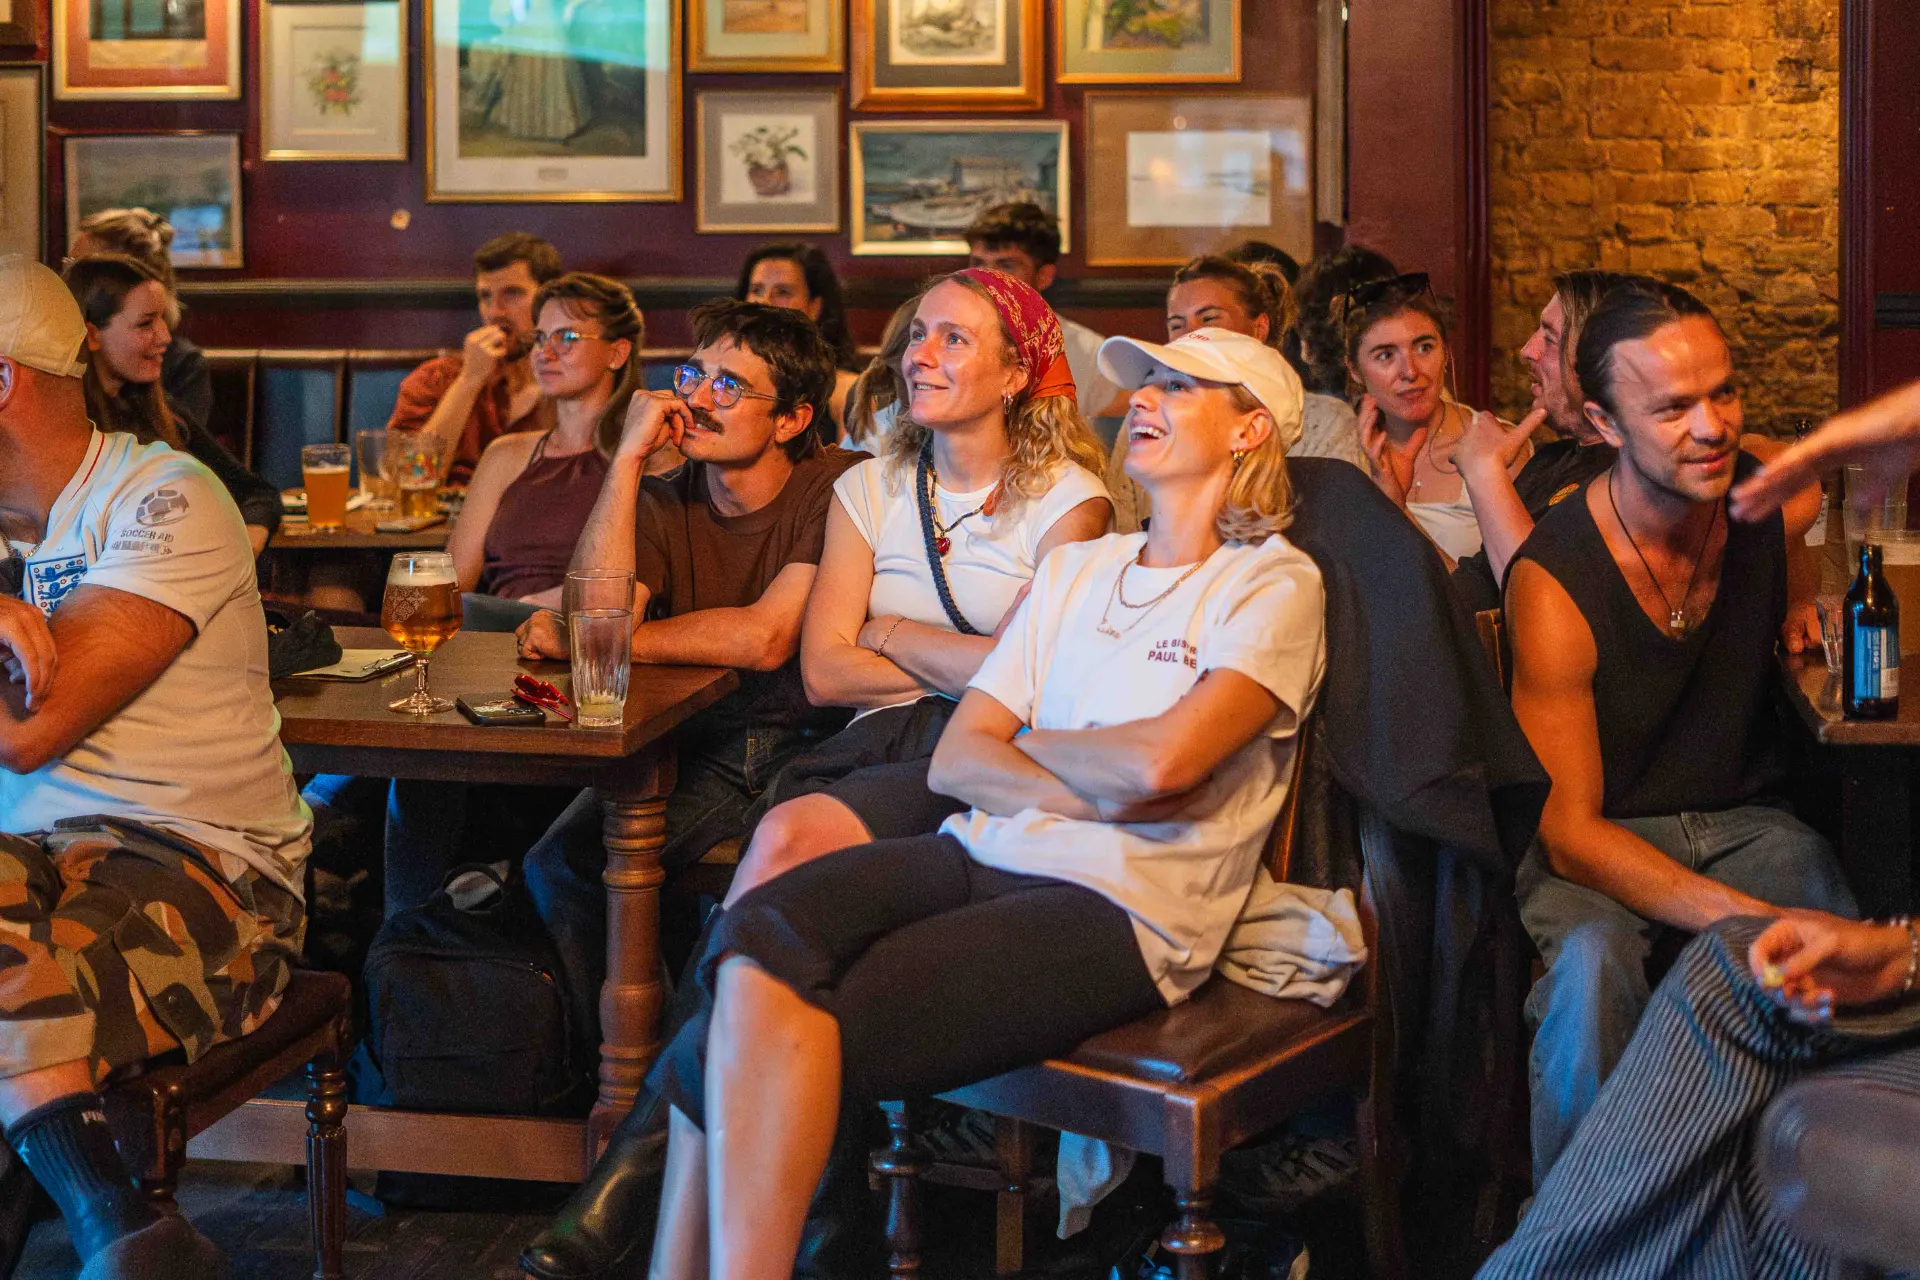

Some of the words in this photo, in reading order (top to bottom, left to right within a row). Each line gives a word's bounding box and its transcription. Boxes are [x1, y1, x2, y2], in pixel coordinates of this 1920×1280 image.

[120, 529, 156, 540] SOCCER
[157, 532, 174, 542] AID
[1156, 640, 1168, 649] LE
[1147, 650, 1178, 663] PAUL
